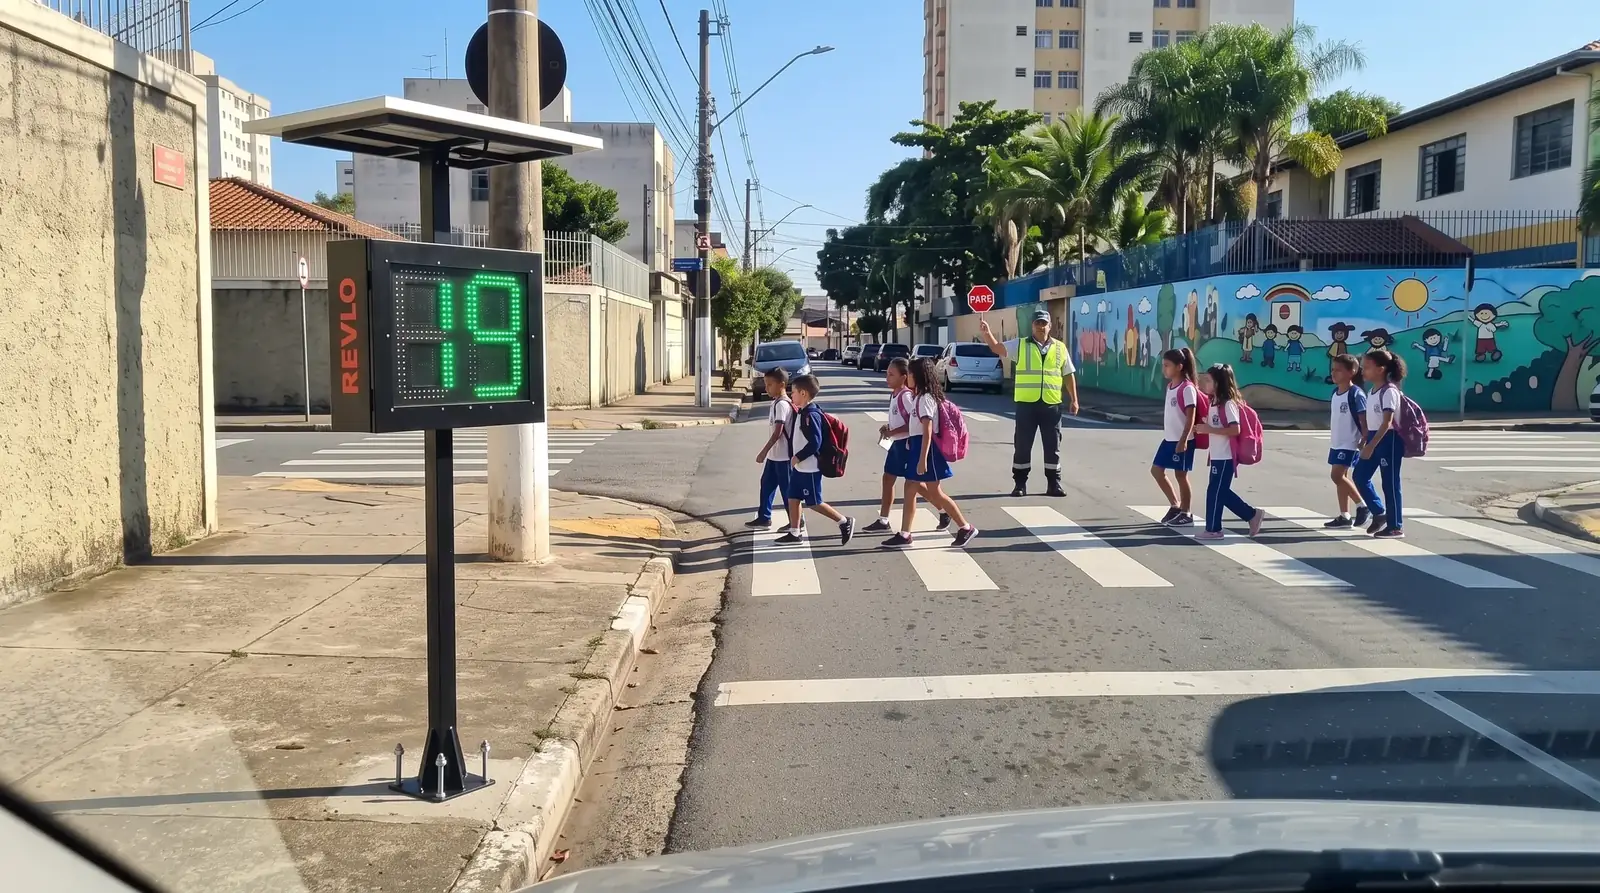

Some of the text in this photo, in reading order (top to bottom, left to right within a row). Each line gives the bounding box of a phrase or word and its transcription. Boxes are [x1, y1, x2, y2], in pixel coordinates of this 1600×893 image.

[339, 278, 359, 394] REVLO
[439, 274, 521, 397] 19
[969, 294, 993, 304] PARE
